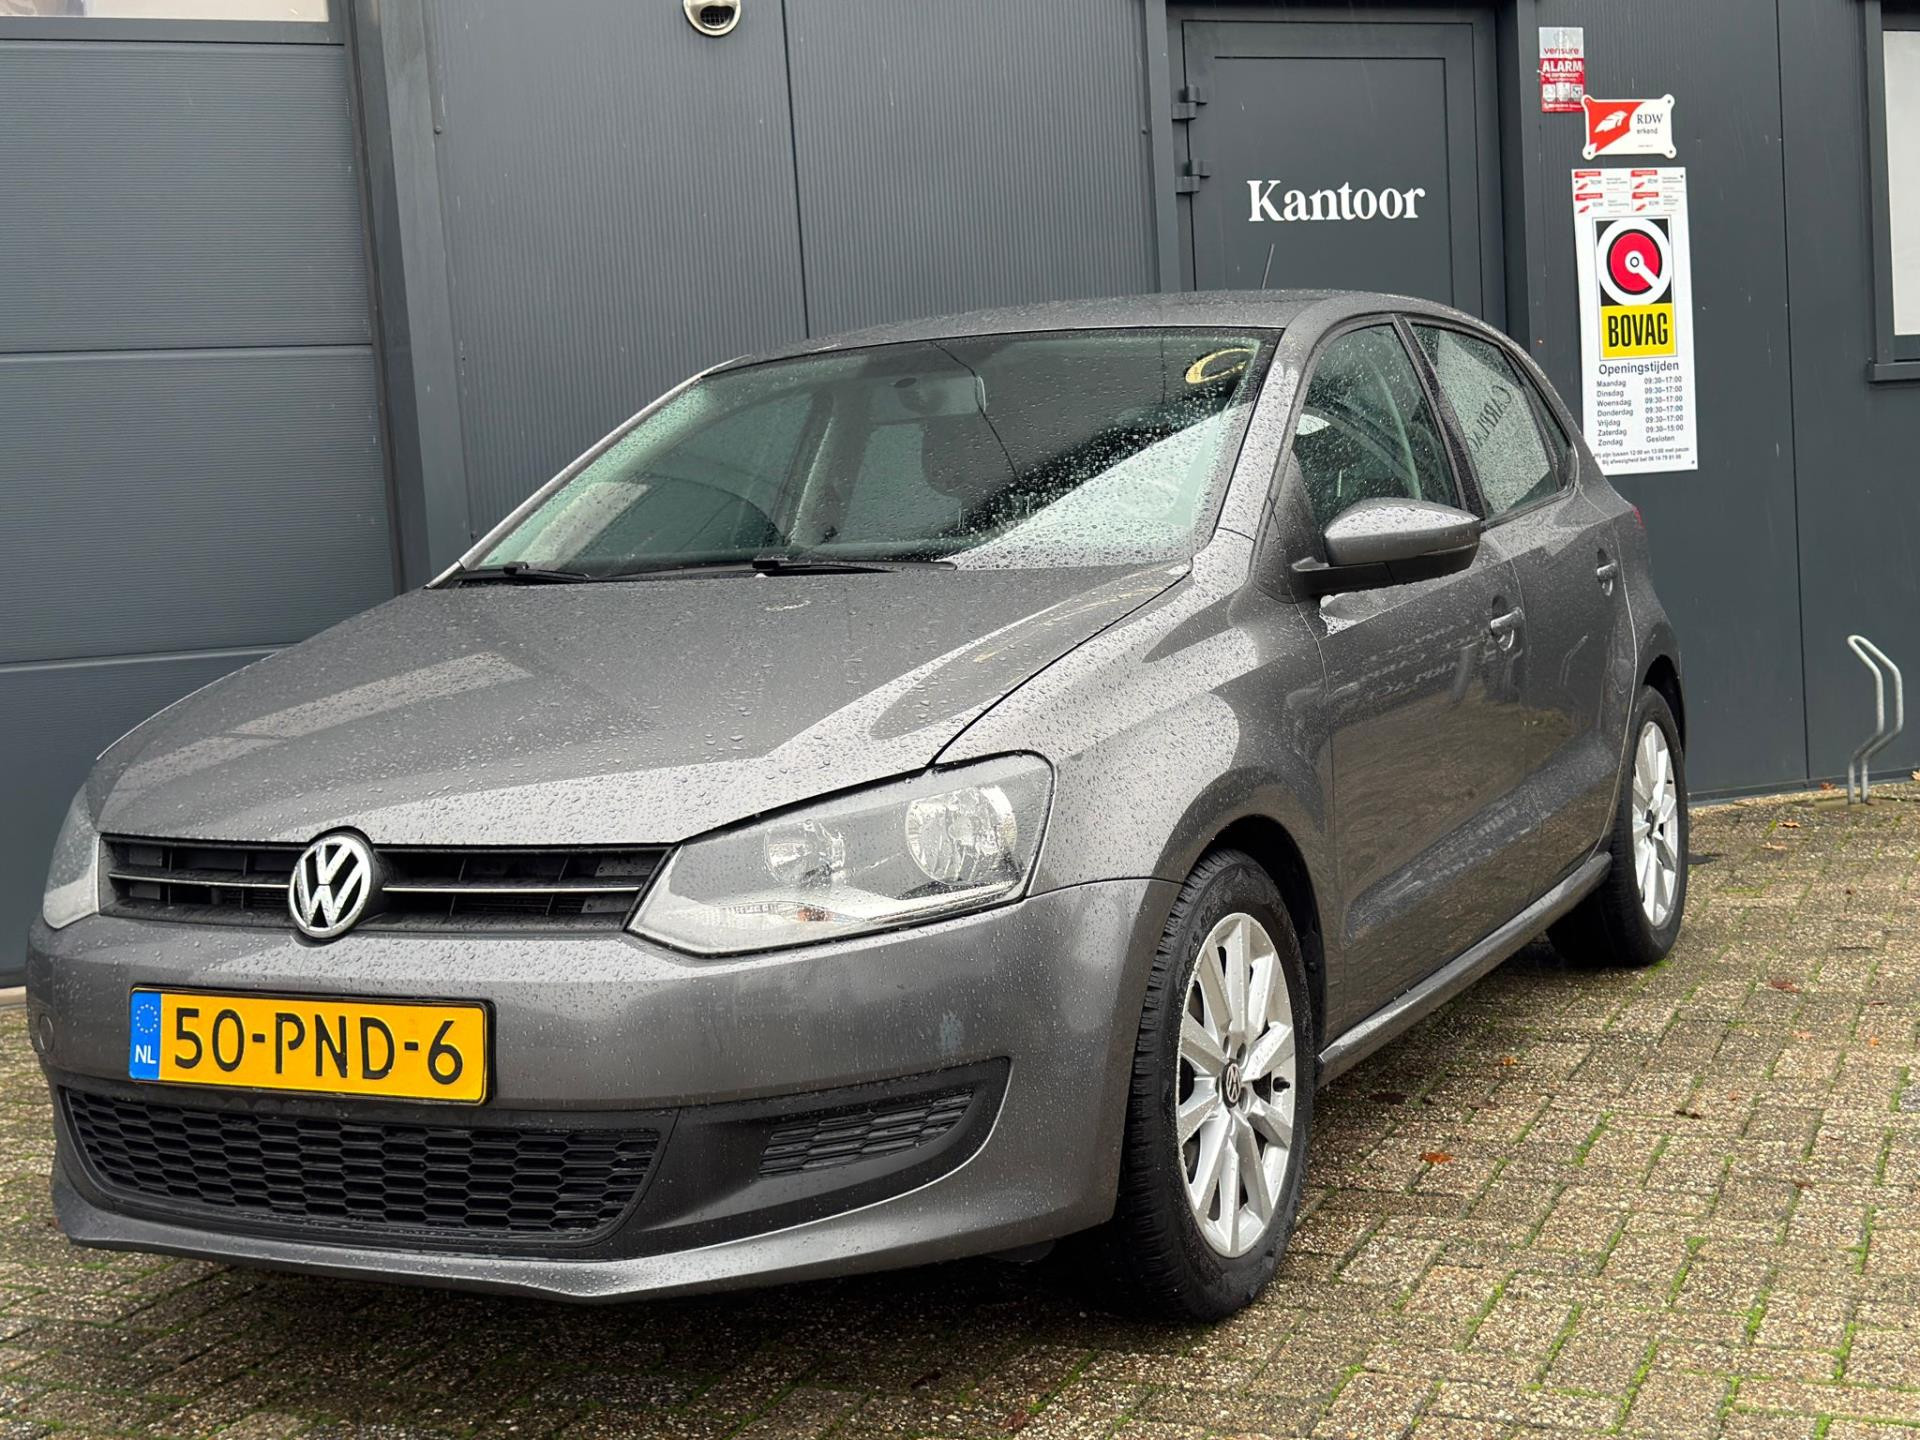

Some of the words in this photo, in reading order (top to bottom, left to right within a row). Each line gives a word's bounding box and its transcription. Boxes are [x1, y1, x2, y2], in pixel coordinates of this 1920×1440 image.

[1542, 60, 1582, 73] ALARM
[1636, 113, 1663, 125] RDW
[1247, 180, 1426, 222] Kantoor
[1607, 312, 1668, 347] BOVAG
[1598, 361, 1679, 376] Openingstijden
[1596, 380, 1627, 388] Maandag
[1596, 390, 1624, 398] Dinsdag
[1597, 399, 1632, 407] Woensdag
[1597, 409, 1634, 417] Donderdag
[1597, 419, 1621, 427] Vrijdag
[1597, 429, 1627, 437] Zaterdag
[1646, 435, 1675, 443] Gesloten
[175, 1007, 463, 1085] 50-PND-6
[134, 1044, 157, 1065] NL
